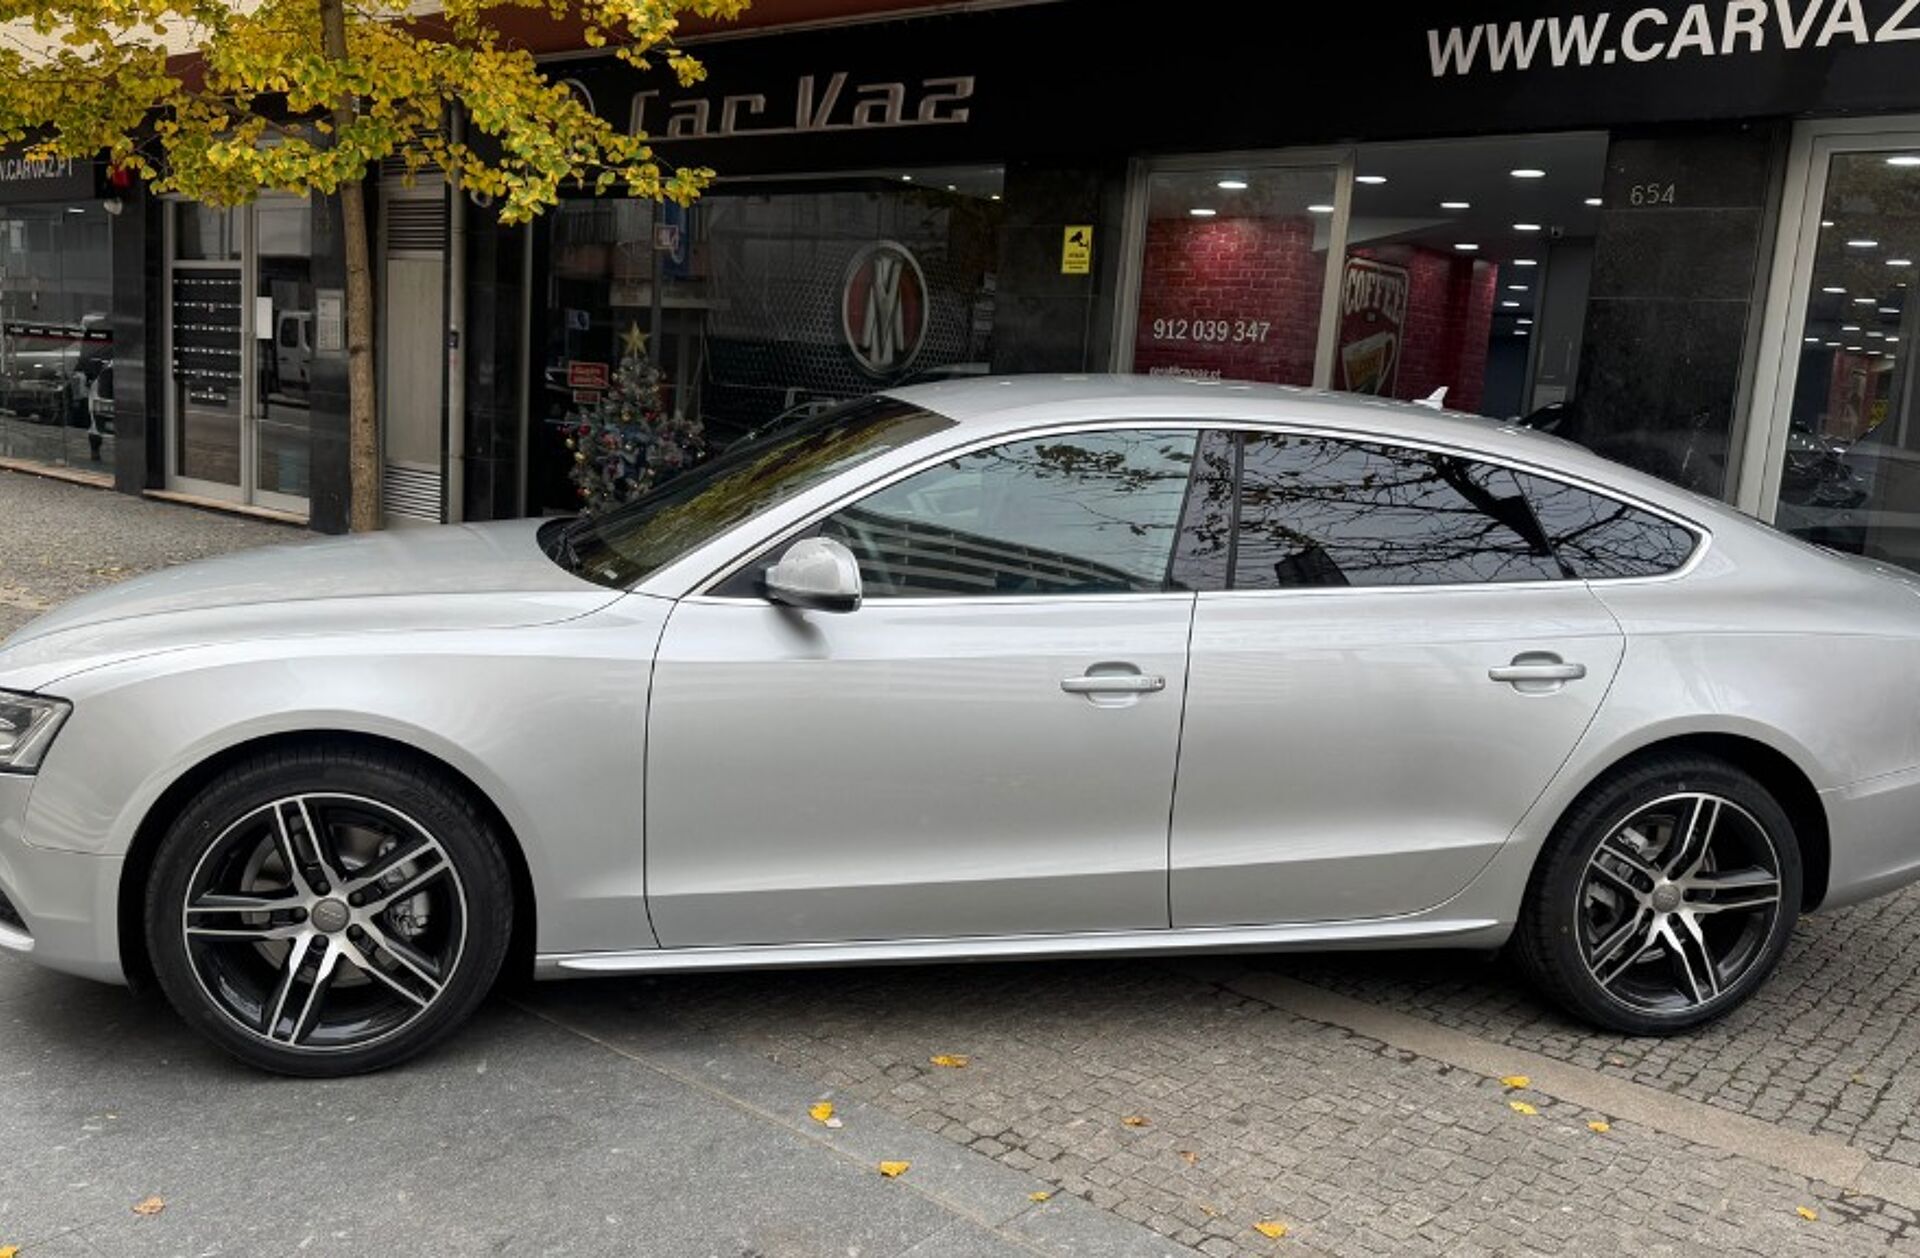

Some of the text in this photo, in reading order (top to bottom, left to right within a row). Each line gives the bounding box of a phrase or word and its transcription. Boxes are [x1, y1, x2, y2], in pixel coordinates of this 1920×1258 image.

[1630, 183, 1675, 206] 654
[1153, 319, 1271, 342] 912 039 347
